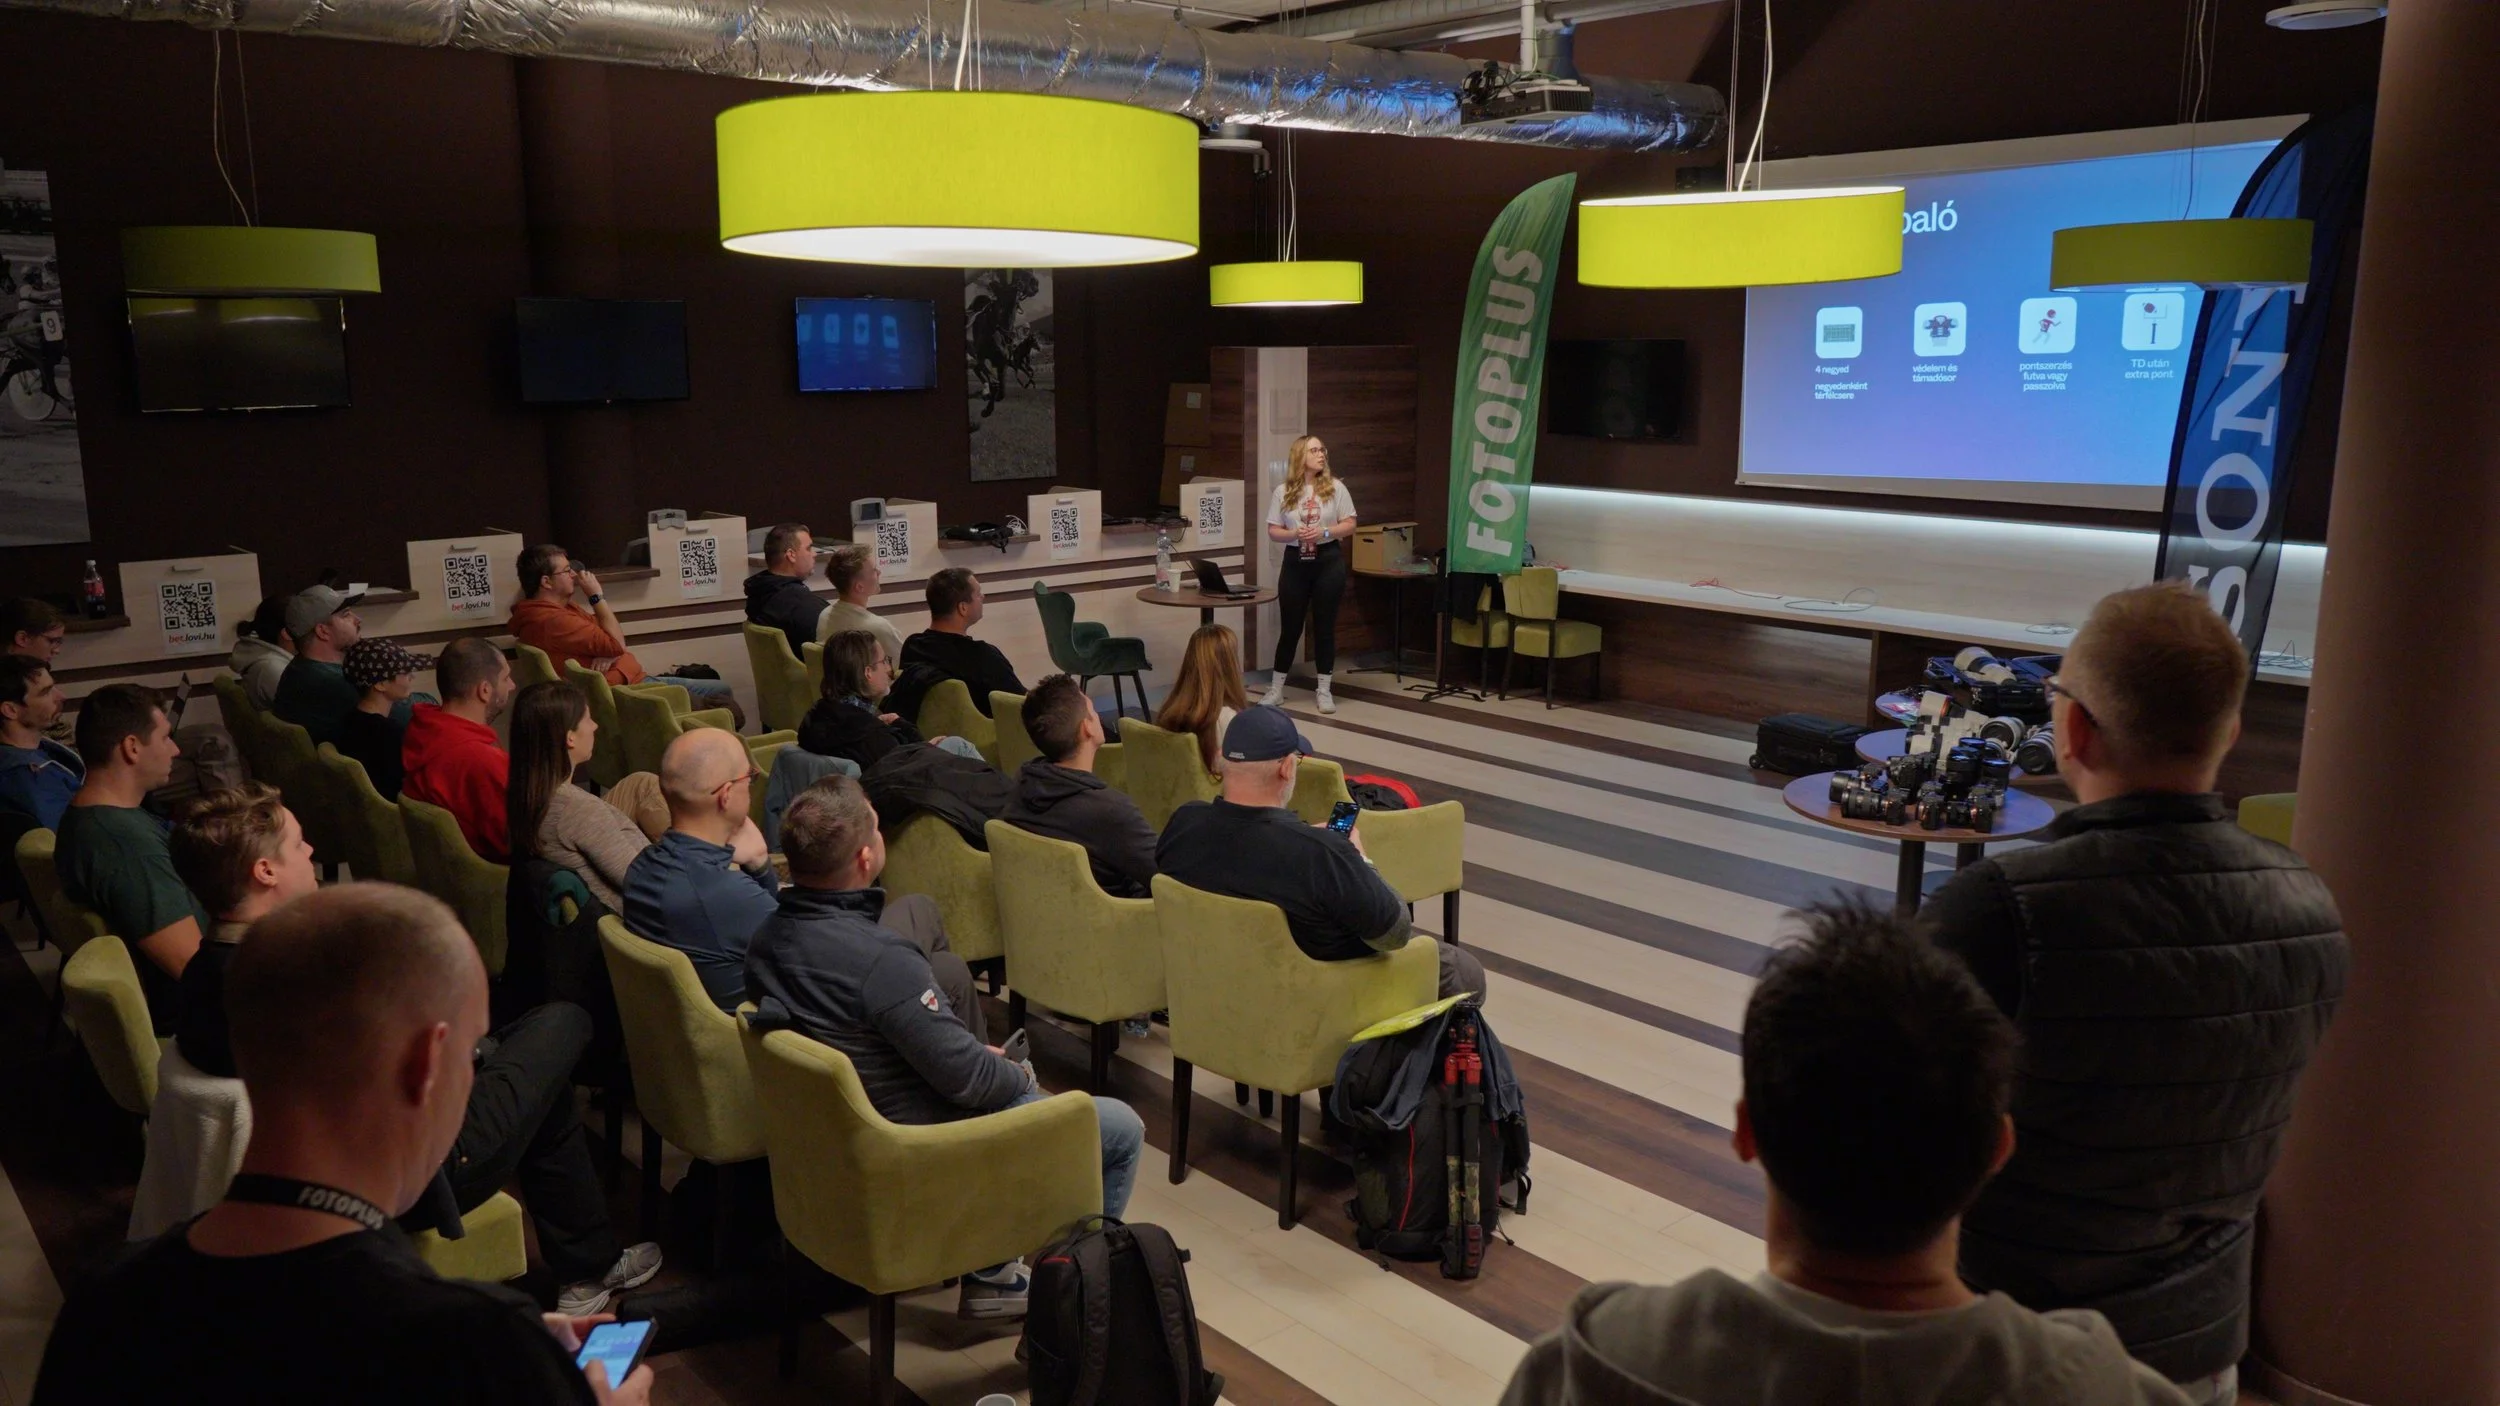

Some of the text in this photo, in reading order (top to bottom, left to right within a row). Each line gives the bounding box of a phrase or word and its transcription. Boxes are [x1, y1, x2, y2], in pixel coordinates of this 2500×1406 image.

[46, 317, 57, 335] 9
[1913, 363, 1958, 373] védelem és
[2019, 360, 2072, 372] pontszerzés
[2131, 358, 2170, 369] TD után
[1815, 365, 1849, 376] 4 negyed
[2125, 369, 2174, 381] extra pont
[1913, 373, 1957, 382] támadósor
[2023, 371, 2068, 383] futva vagy
[1815, 382, 1868, 394] negyedenként
[2023, 381, 2066, 392] passzolva
[1466, 245, 1543, 557] FOTOPLUS
[1815, 391, 1855, 400] térfélcsere
[683, 578, 716, 586] bet.lovi.hu
[452, 601, 491, 611] bet.lovi.hu
[168, 633, 215, 643] bet.lovi.hu
